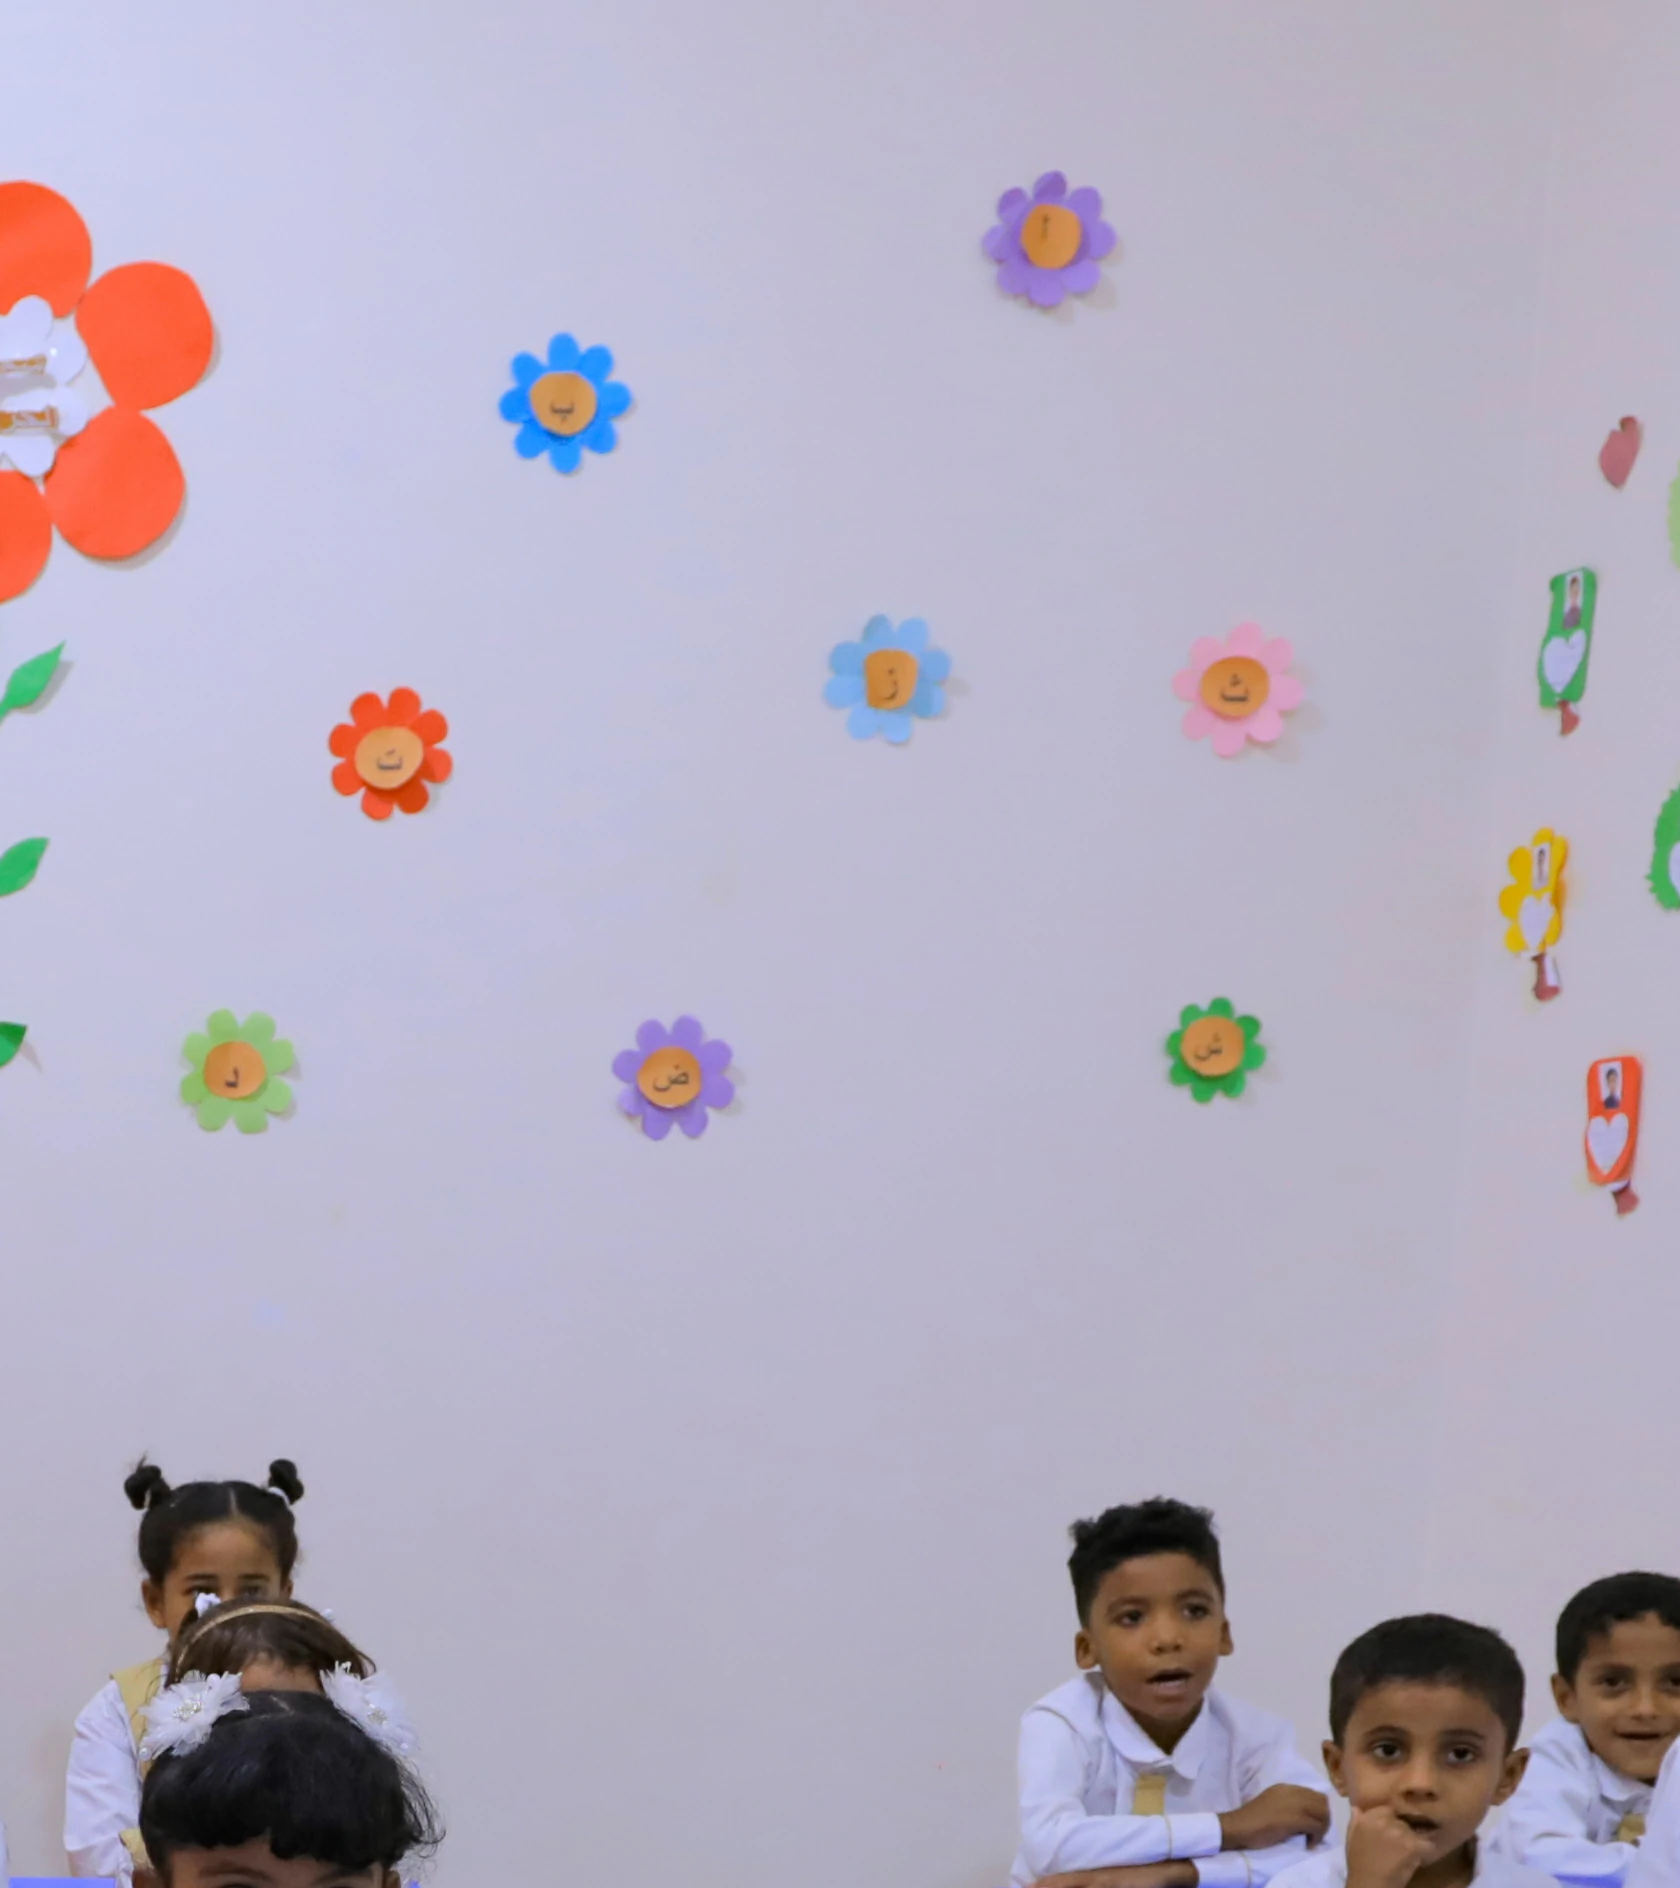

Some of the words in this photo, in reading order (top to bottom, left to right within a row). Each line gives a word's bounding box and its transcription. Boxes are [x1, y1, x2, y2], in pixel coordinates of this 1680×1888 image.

[550, 400, 575, 423] ب
[883, 668, 899, 700] ز
[653, 1063, 690, 1092] ض
